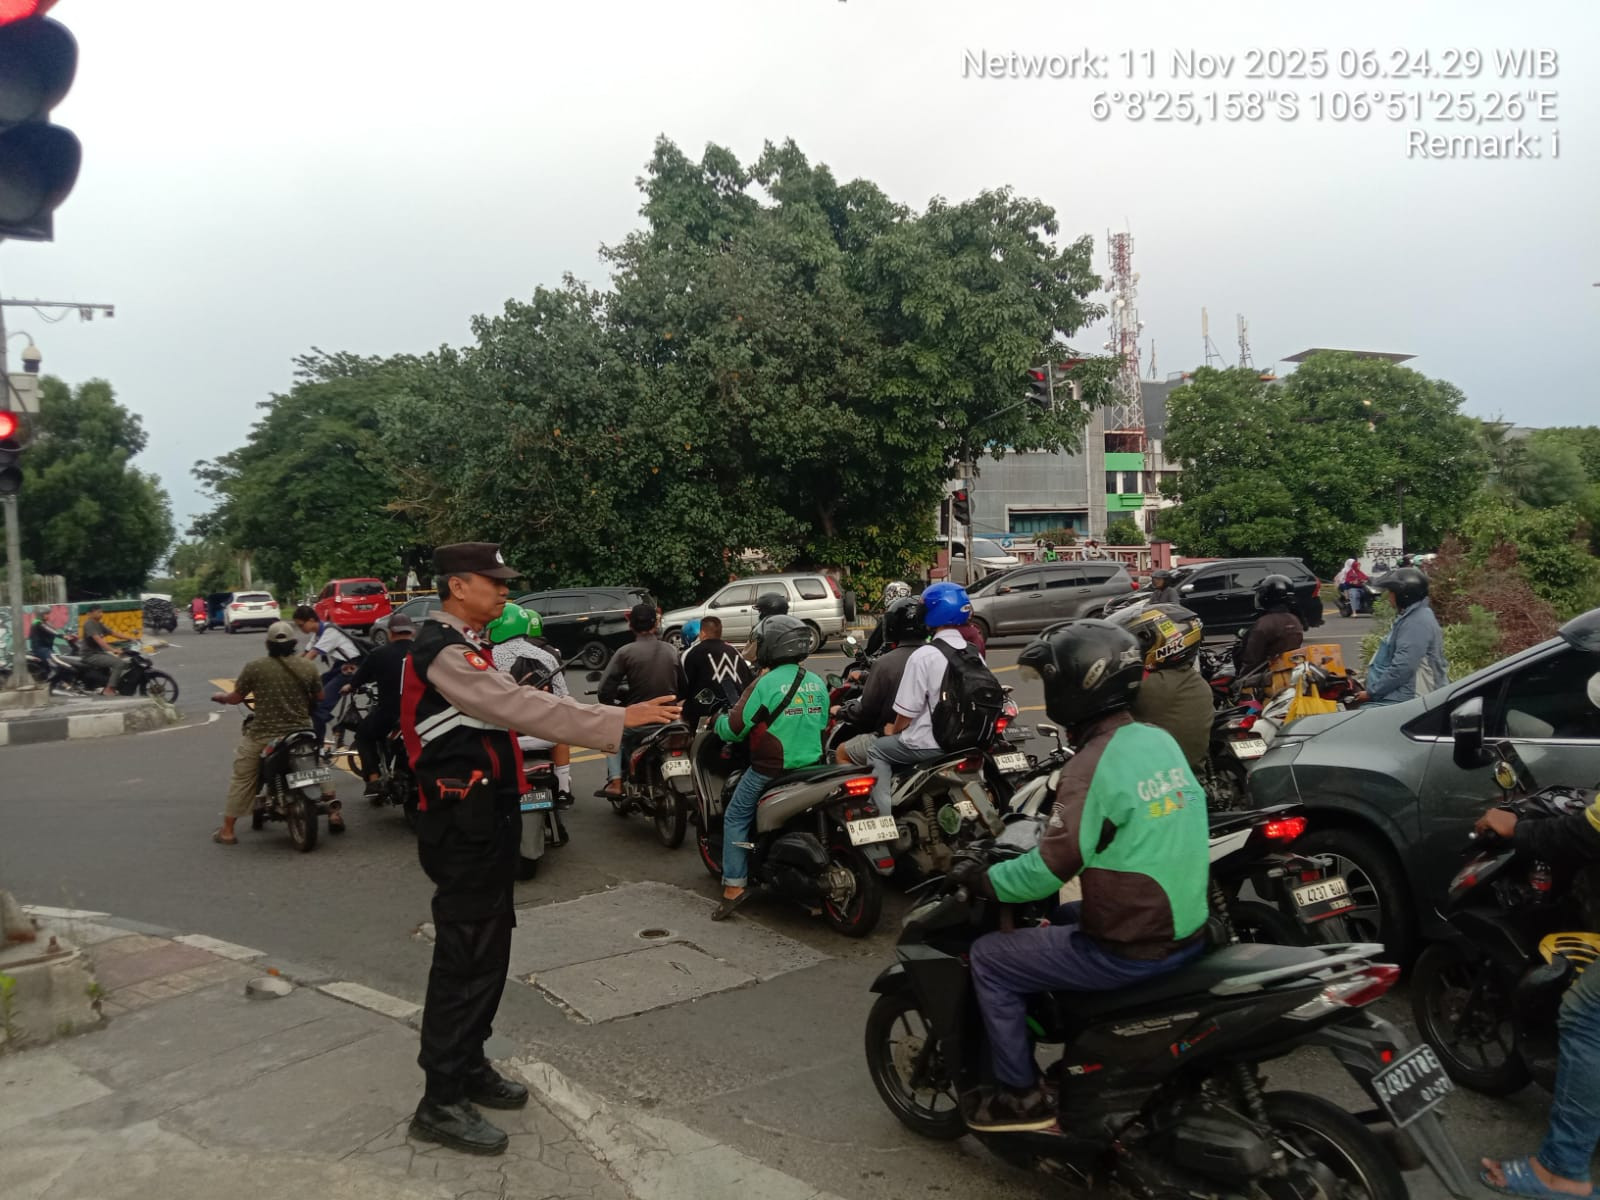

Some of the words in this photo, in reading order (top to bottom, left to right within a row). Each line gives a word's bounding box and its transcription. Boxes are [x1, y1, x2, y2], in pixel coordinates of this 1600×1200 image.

[1156, 638, 1184, 660] NHK
[1296, 892, 1305, 905] B
[1307, 885, 1328, 903] 4237
